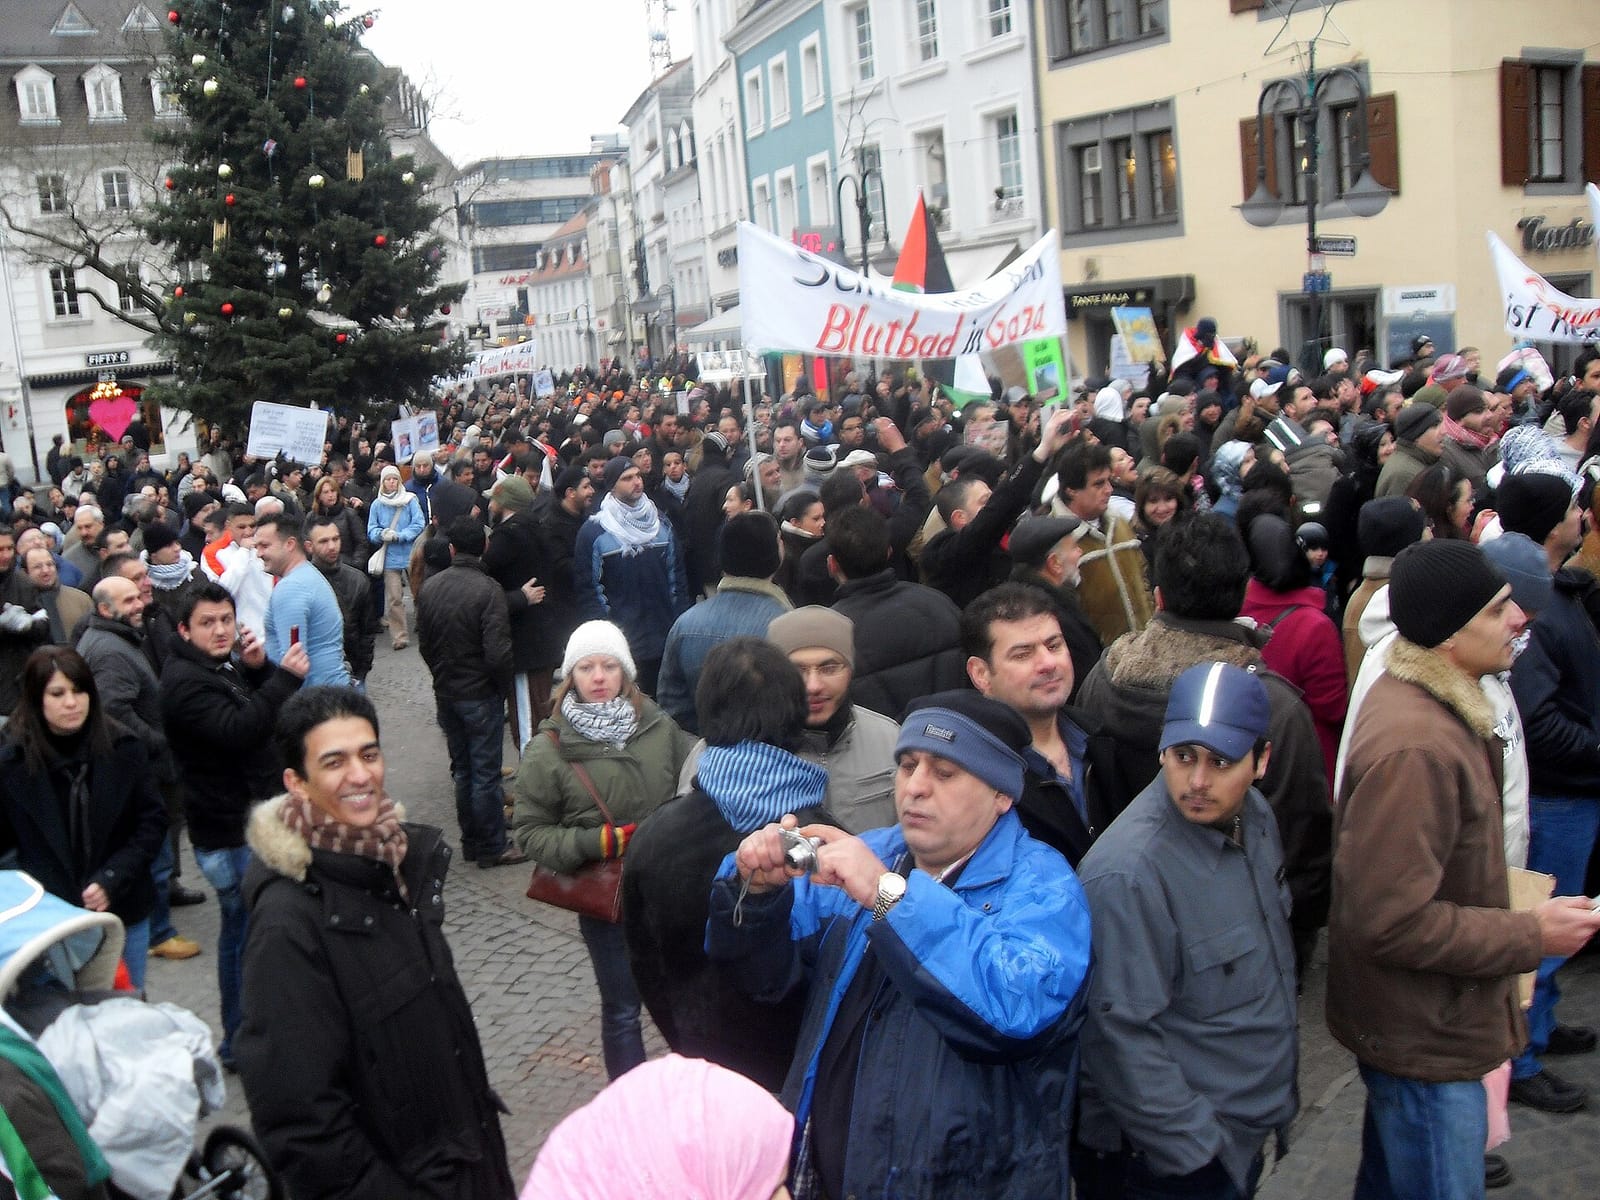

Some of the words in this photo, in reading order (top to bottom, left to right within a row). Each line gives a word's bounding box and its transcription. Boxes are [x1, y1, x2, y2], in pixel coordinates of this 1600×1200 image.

[1072, 294, 1101, 307] TANTE
[816, 303, 965, 358] Blutbad
[962, 318, 984, 354] in
[985, 302, 1046, 348] Gaza
[89, 353, 119, 366] FIFTY
